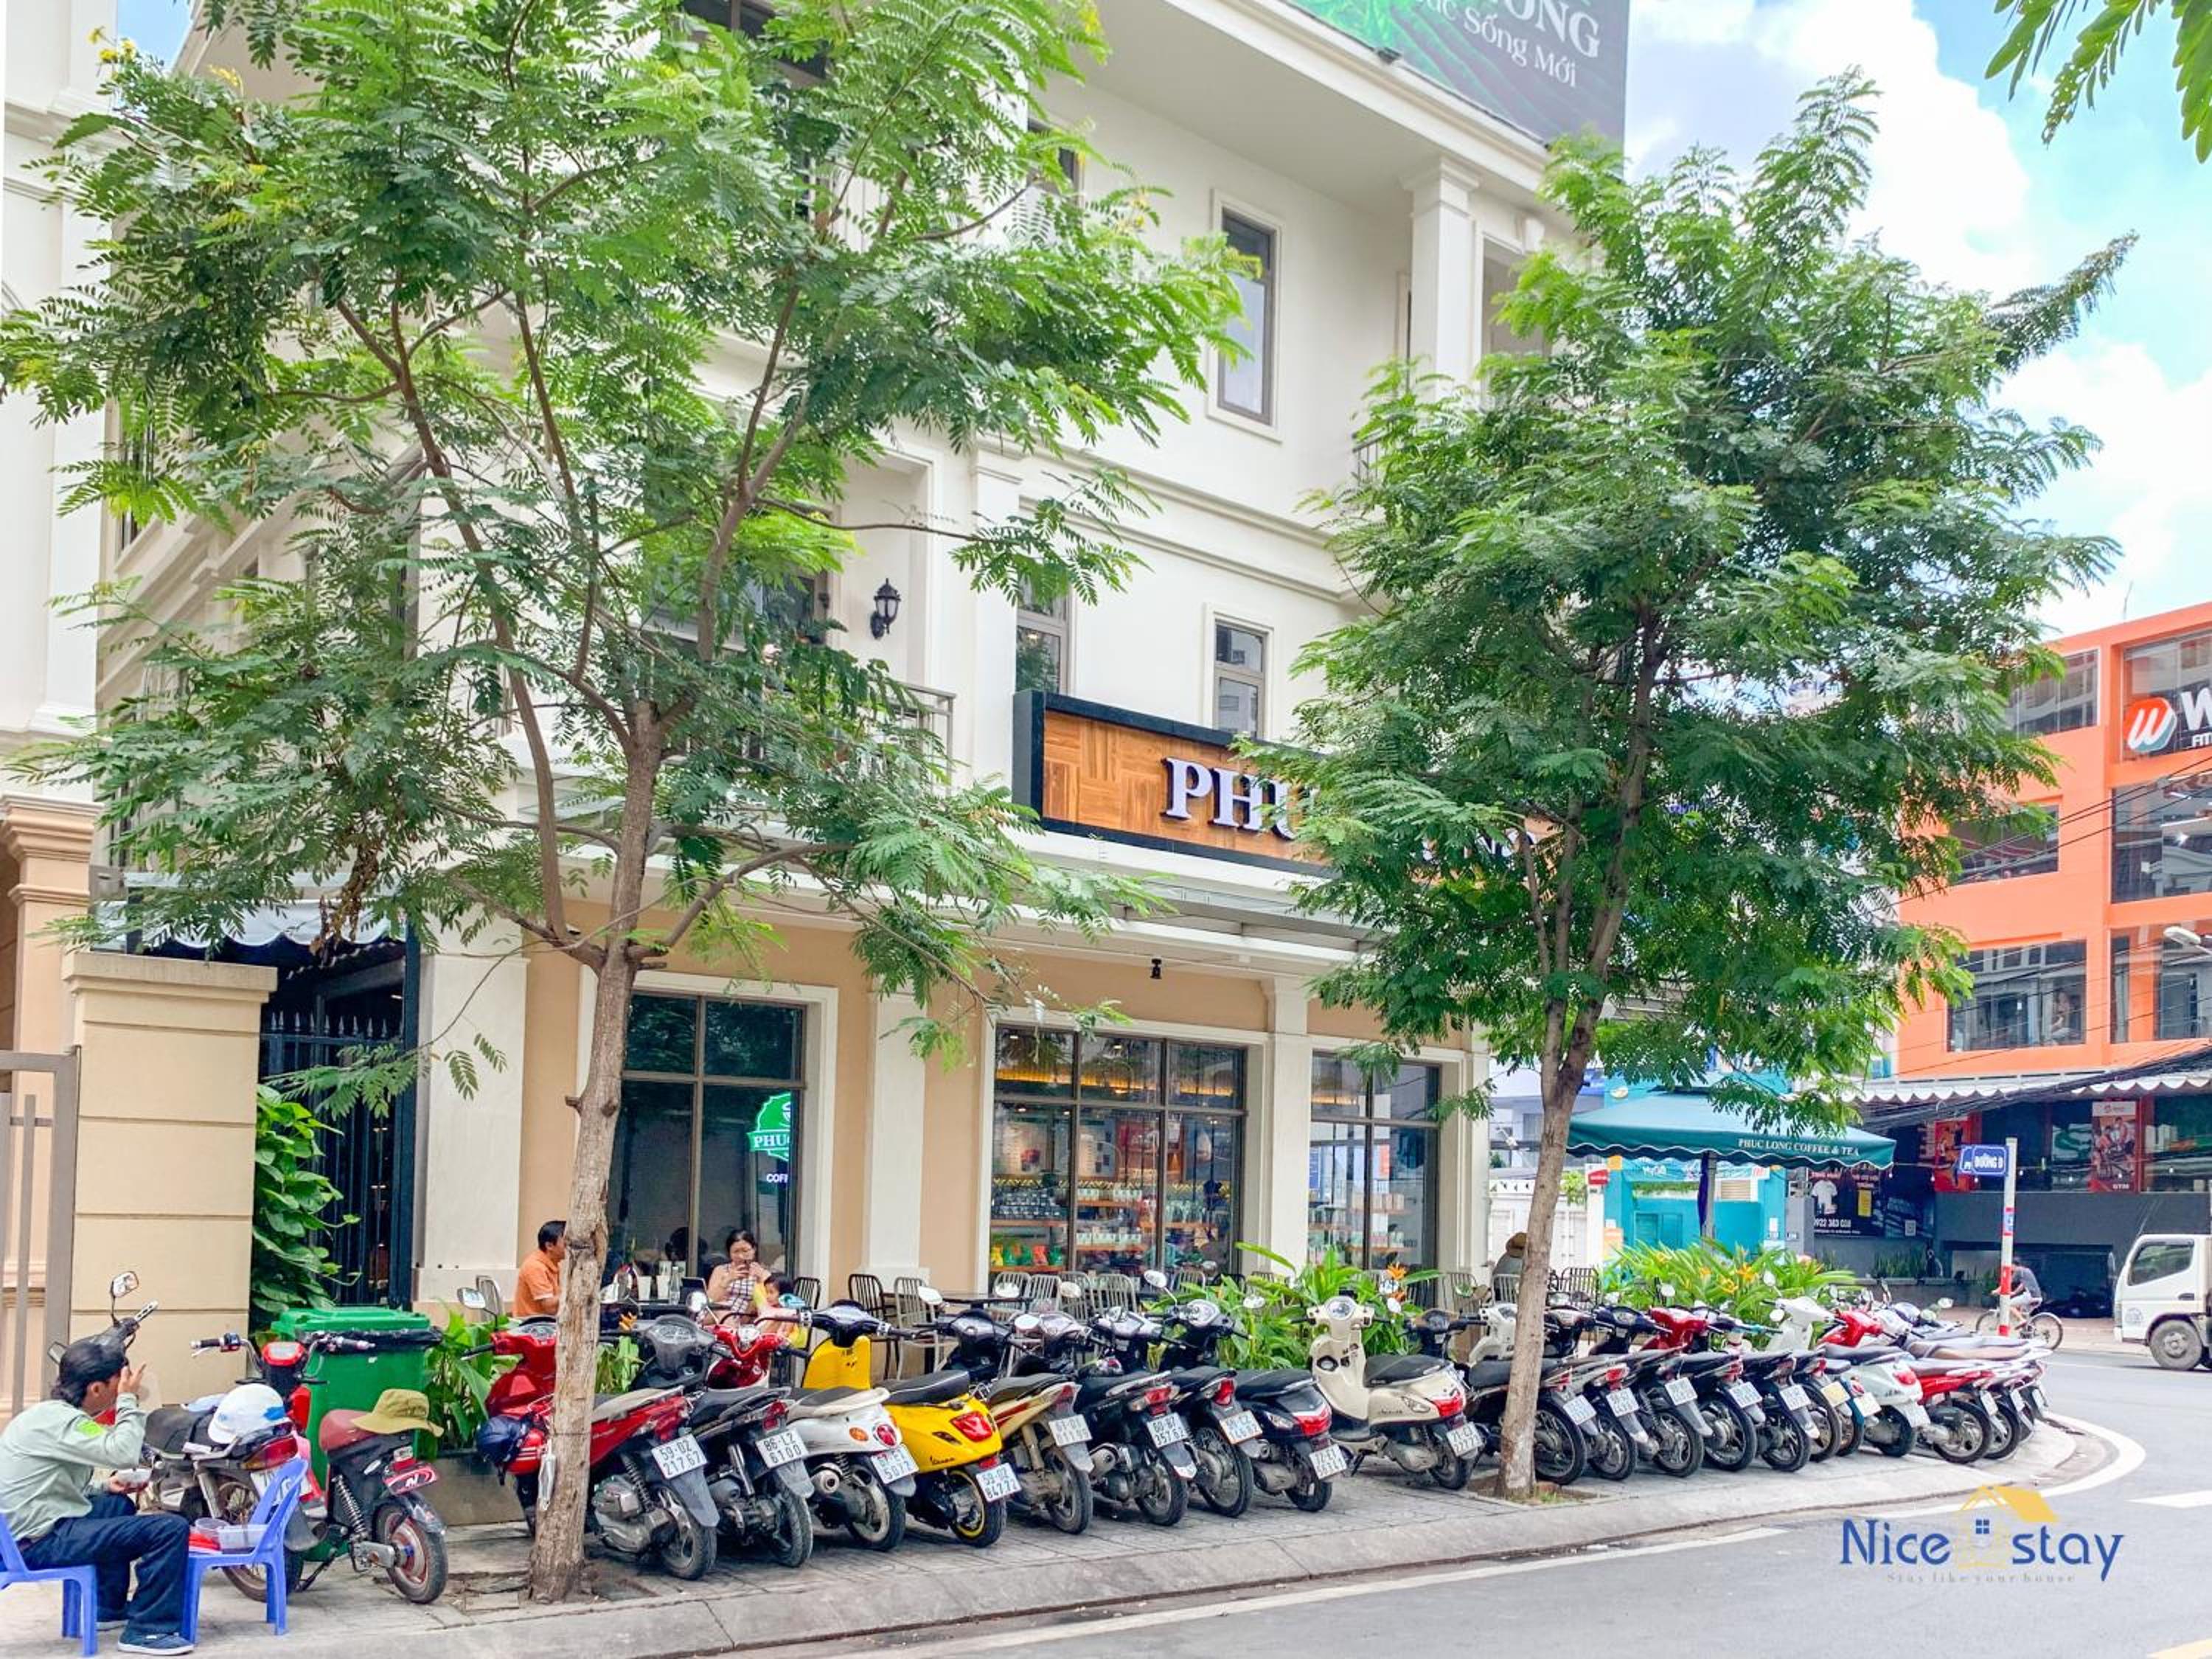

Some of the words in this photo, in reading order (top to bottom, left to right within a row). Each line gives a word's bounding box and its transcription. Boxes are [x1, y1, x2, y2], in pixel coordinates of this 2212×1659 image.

[1534, 44, 1576, 88] Mới
[754, 1135, 790, 1148] PHU
[1765, 1140, 1793, 1151] LONG
[1793, 1142, 1830, 1154] COFFEE
[1831, 1145, 1840, 1155] &
[1841, 1146, 1860, 1157] TEA
[768, 1443, 802, 1464] 6100
